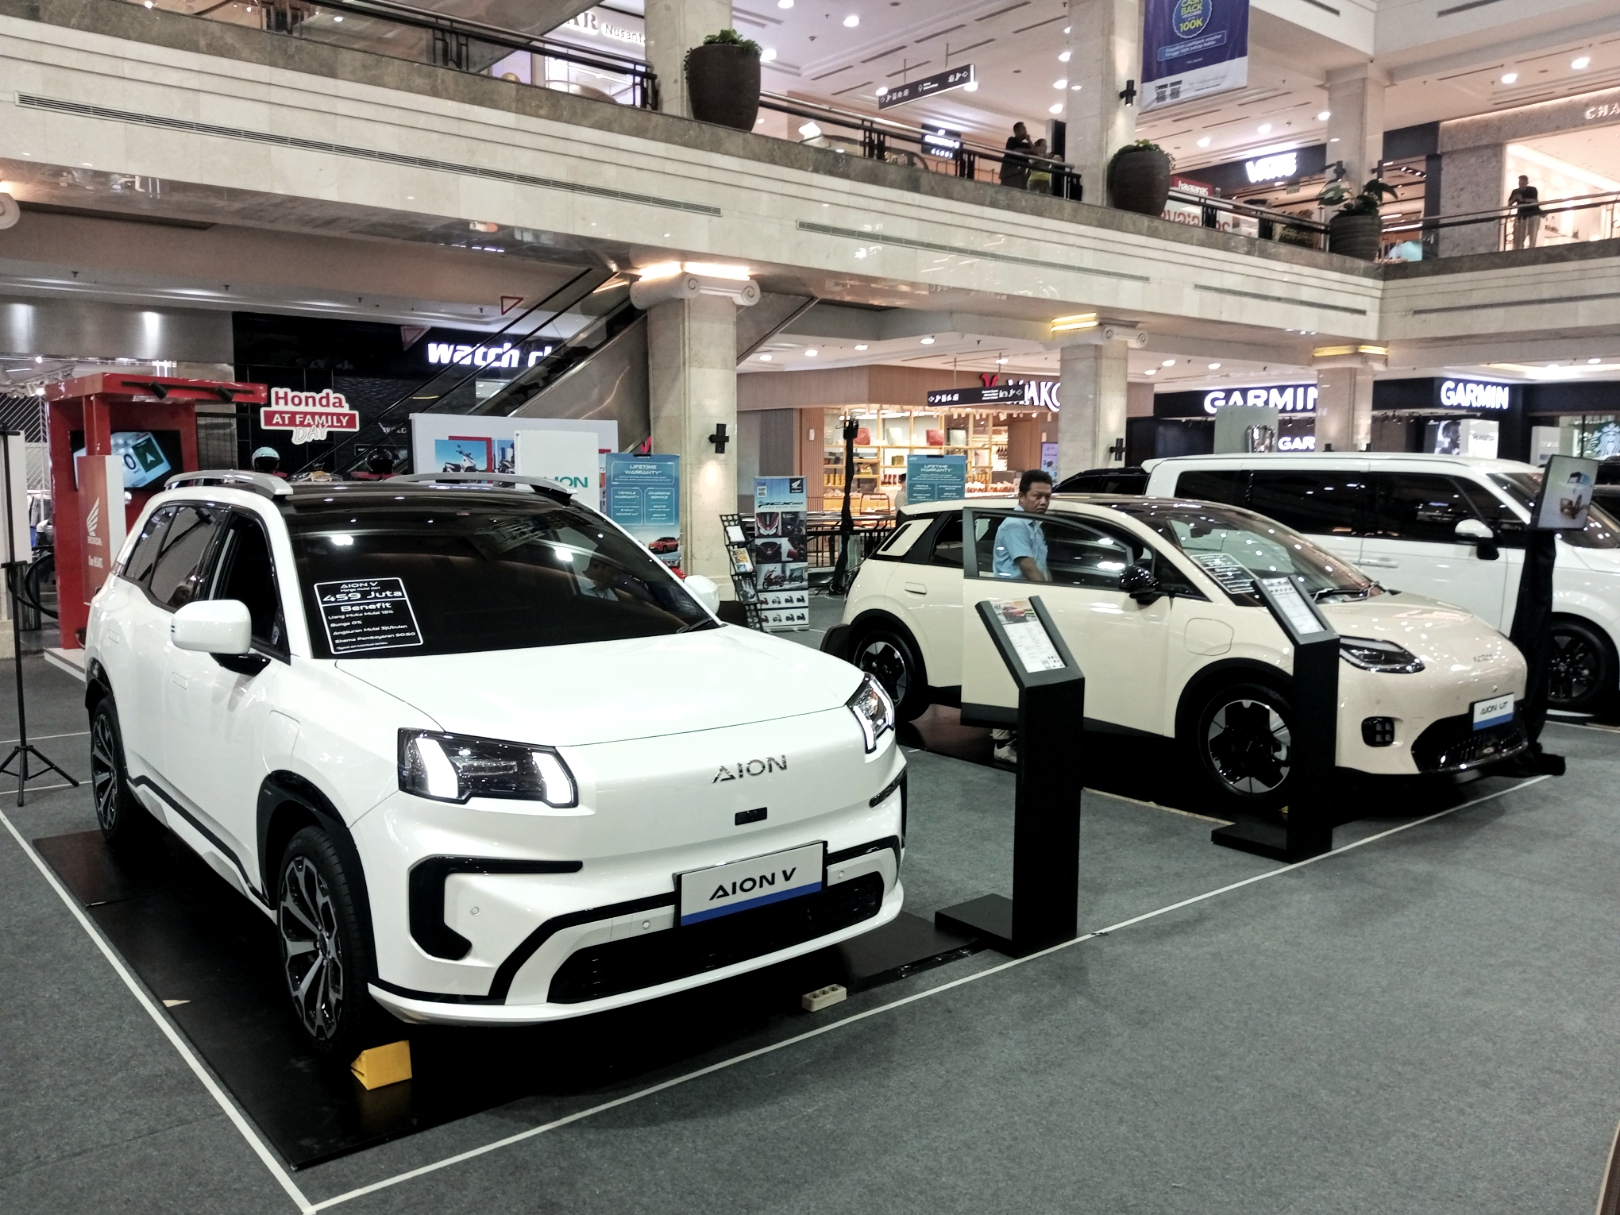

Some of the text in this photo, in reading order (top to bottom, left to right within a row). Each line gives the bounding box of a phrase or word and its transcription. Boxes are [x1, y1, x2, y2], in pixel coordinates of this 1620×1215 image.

[1181, 4, 1203, 15] BACK
[1179, 17, 1203, 32] 100K
[605, 24, 645, 43] Nusant
[428, 342, 520, 368] watch
[273, 390, 345, 409] Honda
[1440, 380, 1510, 410] GARMIN
[272, 413, 350, 426] AT FAMILY
[294, 422, 330, 442] DAY
[554, 475, 589, 488] ON
[322, 590, 403, 601] 459 Juta
[341, 602, 392, 612] Benefit
[1479, 701, 1508, 715] AION UT
[711, 754, 788, 784] AION
[708, 866, 797, 901] AION V
